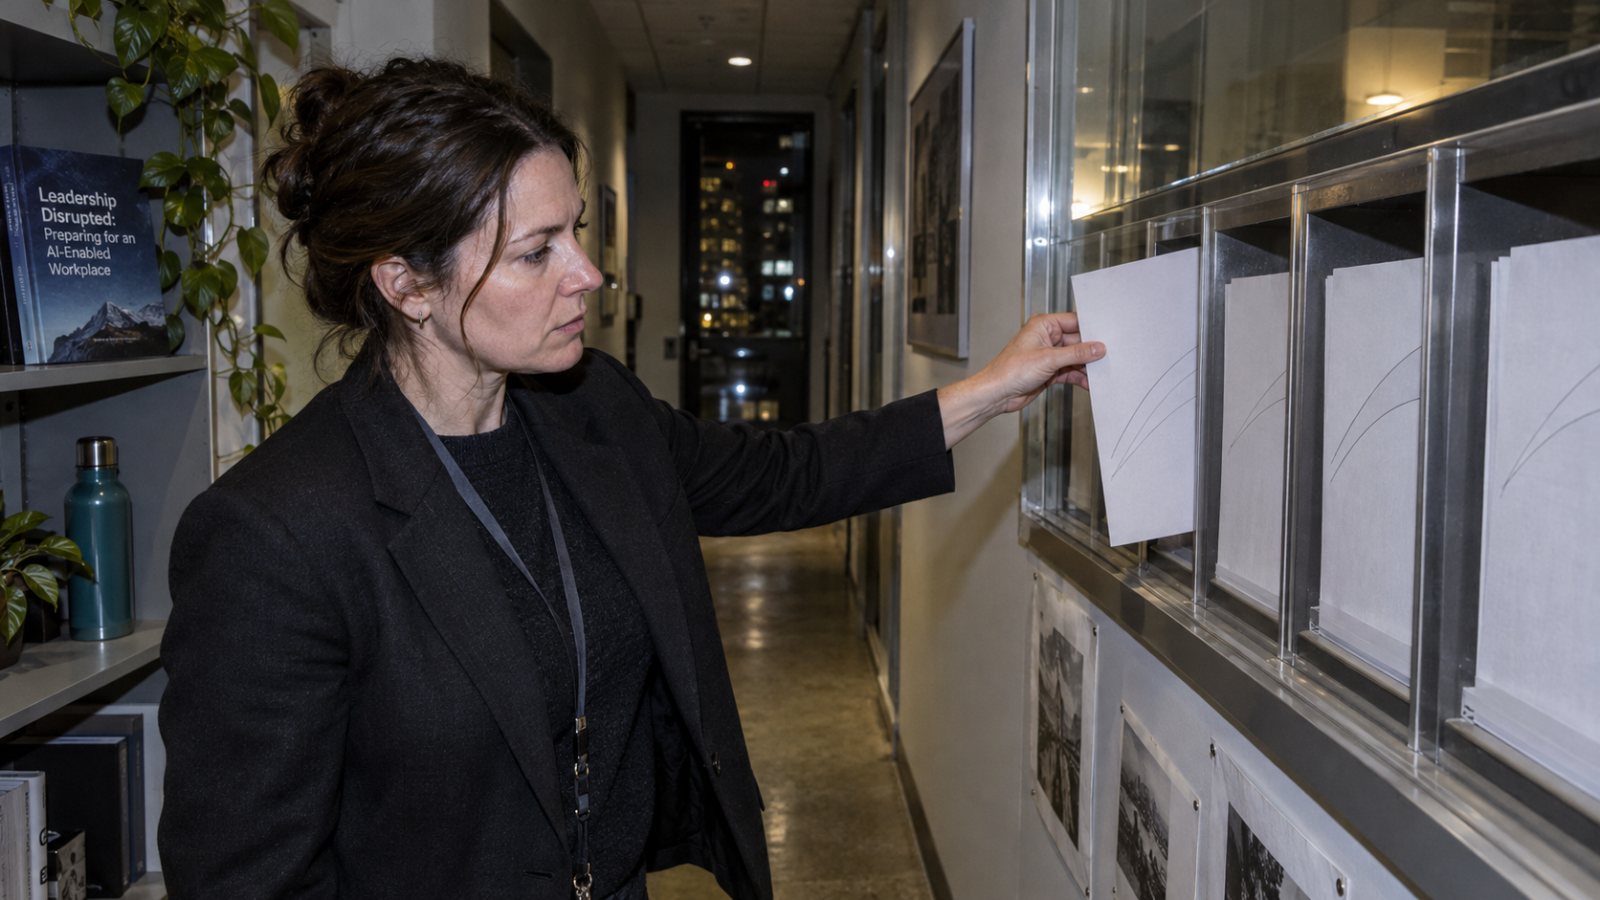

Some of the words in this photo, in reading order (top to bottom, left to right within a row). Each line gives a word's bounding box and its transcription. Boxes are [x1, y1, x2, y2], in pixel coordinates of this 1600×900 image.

[38, 186, 117, 211] Leadership
[41, 207, 116, 227] Disrupted:
[44, 227, 101, 245] Preparing
[104, 232, 119, 244] for
[122, 235, 136, 244] an
[47, 246, 111, 260] AI-Enabled
[49, 262, 111, 278] Workplace
